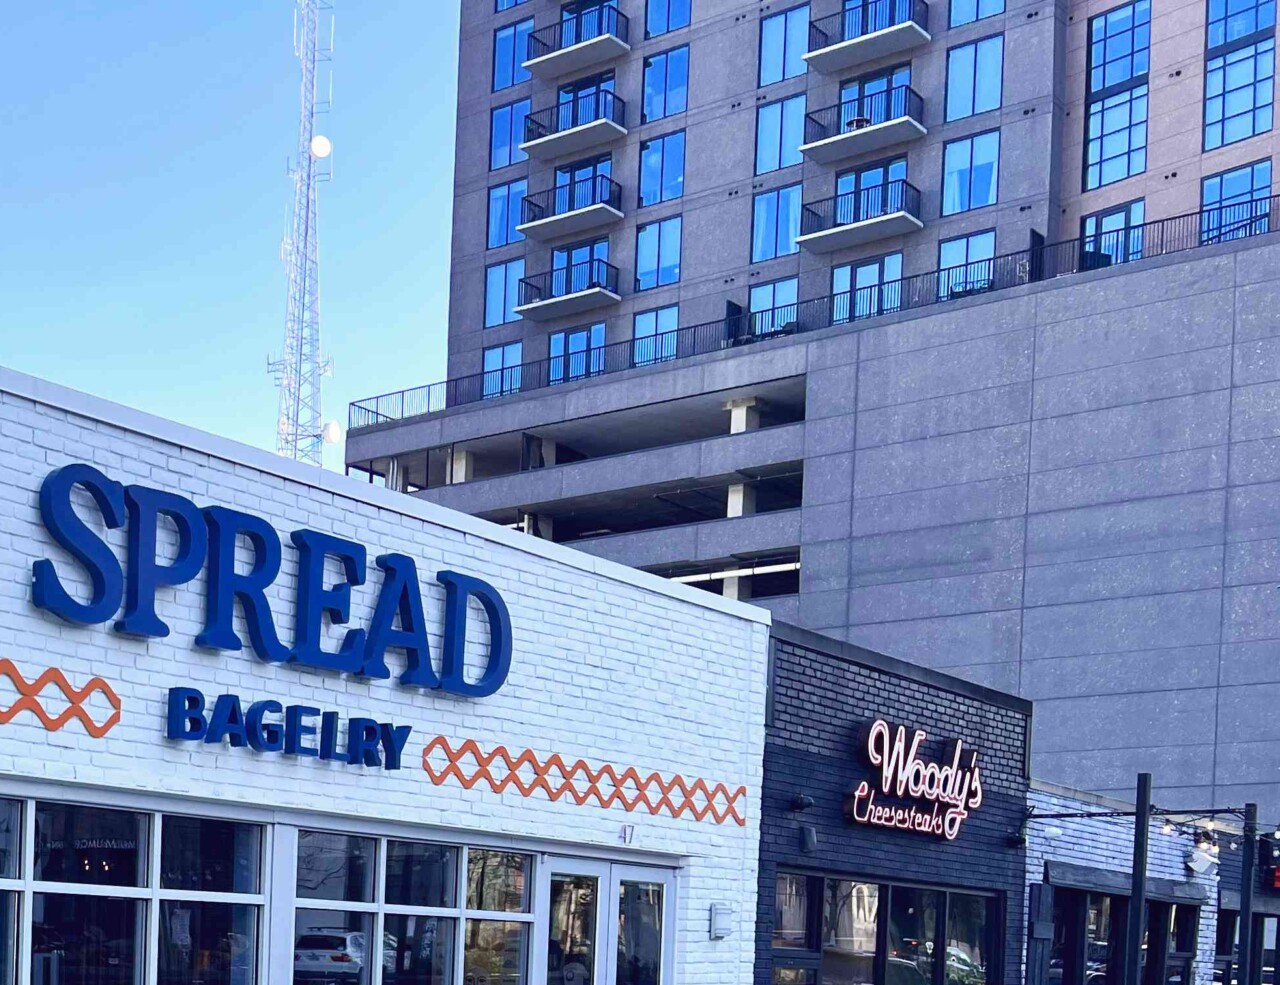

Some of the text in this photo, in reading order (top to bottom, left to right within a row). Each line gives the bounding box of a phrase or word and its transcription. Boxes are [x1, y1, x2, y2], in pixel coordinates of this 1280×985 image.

[33, 463, 513, 698] SPREAD
[167, 686, 413, 770] BAGELRY
[853, 780, 944, 835] Cheesesteaks
[867, 719, 982, 840] Woody's
[618, 824, 635, 844] 47
